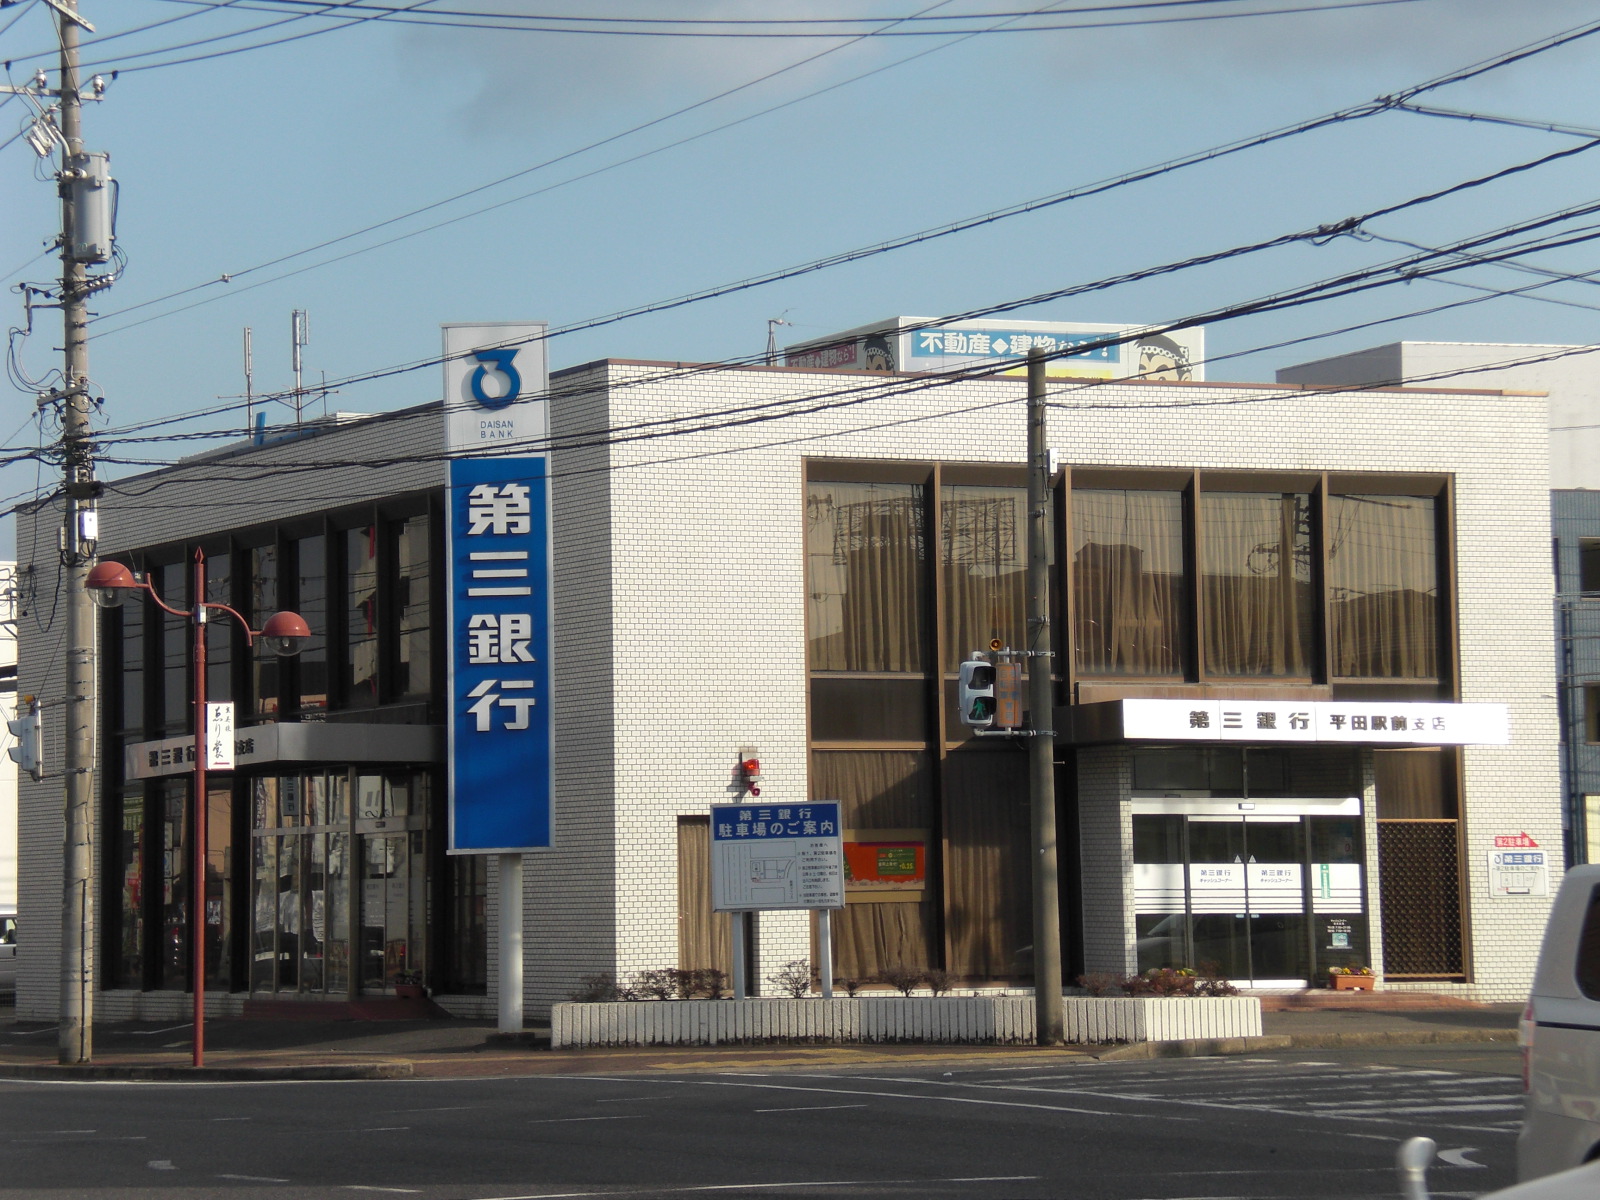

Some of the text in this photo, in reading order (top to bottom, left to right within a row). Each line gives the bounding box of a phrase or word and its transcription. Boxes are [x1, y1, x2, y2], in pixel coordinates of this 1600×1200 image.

[480, 420, 513, 429] DAISAN
[480, 430, 513, 439] BANK
[467, 483, 536, 731] 第三銀行
[1189, 711, 1446, 731] 第三銀行 平田駅前支店
[739, 808, 812, 821] 第三銀行
[719, 820, 834, 837] 駐車場のご案内
